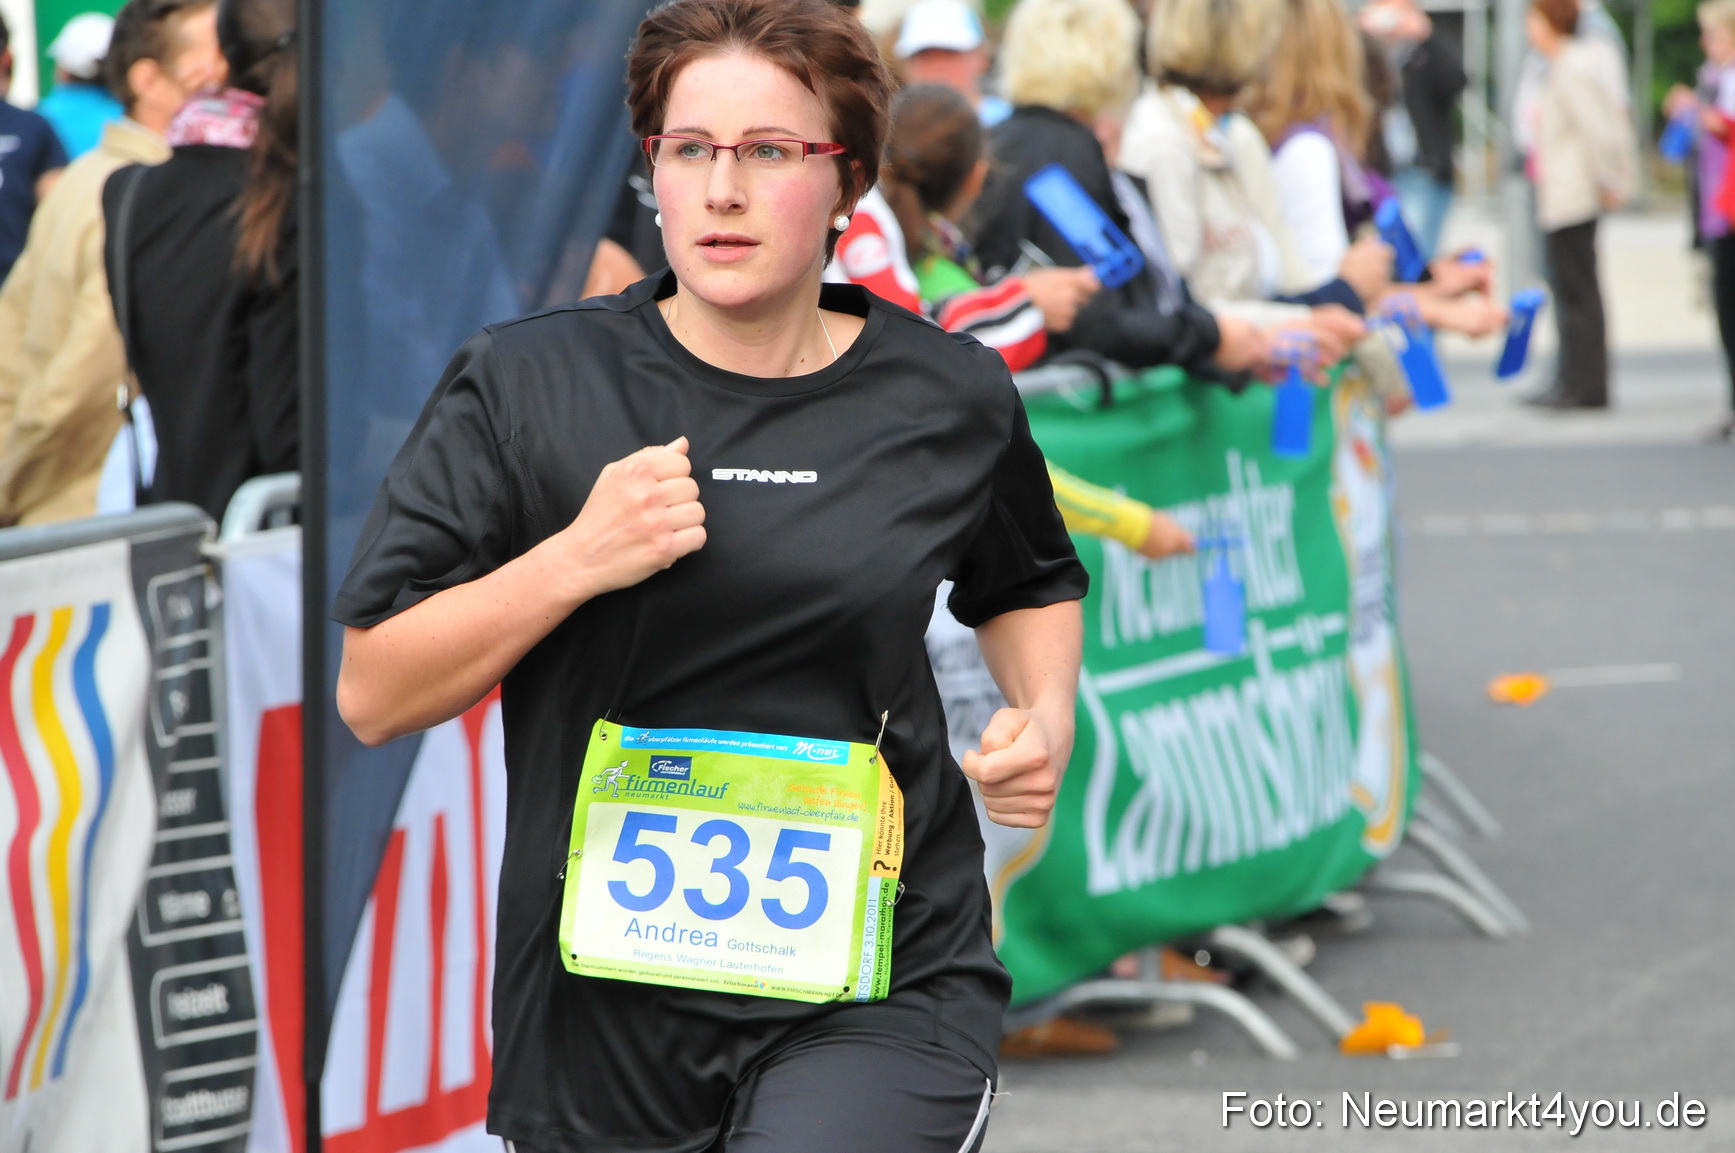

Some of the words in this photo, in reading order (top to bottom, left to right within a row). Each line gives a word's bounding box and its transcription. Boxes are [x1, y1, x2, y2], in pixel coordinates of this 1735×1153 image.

[711, 468, 818, 484] STANNO
[648, 736, 682, 744] oberpfälzer
[718, 738, 740, 747] werden
[741, 740, 774, 750] präsentiert
[792, 740, 844, 760] M-net
[658, 760, 689, 774] Fischer
[625, 774, 730, 800] firmenlauf
[625, 791, 669, 800] neumarkt
[884, 823, 895, 856] Werbung
[606, 810, 832, 931] 535
[864, 899, 877, 948] 3.10.2011
[624, 917, 718, 948] Andrea
[727, 938, 797, 957] Gottschalk
[633, 948, 673, 962] Regens
[676, 953, 717, 967] Wagner
[720, 959, 784, 974] Lauterhofen
